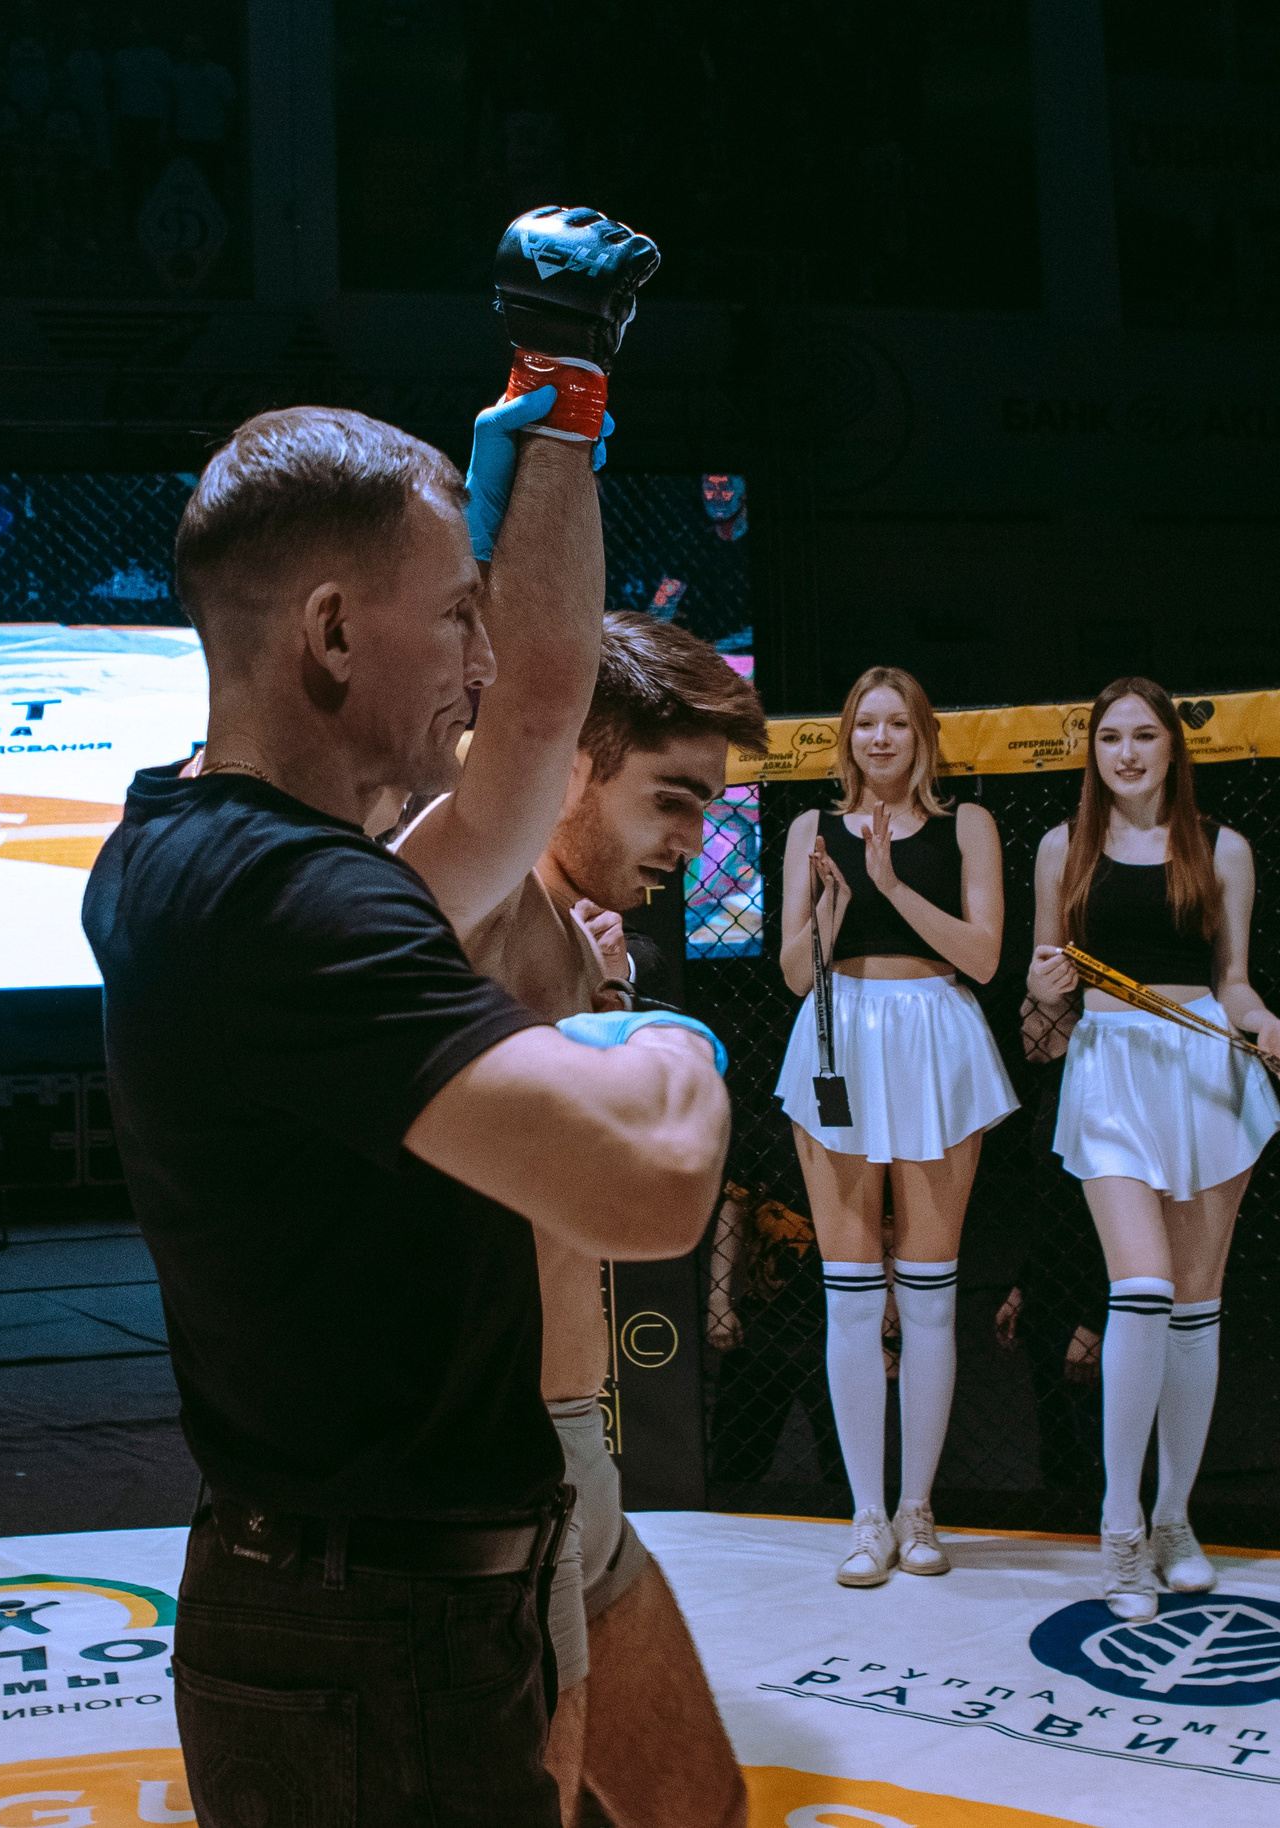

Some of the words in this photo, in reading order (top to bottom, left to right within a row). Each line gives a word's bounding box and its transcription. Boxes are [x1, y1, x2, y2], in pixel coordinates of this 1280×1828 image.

[1008, 739, 1064, 750] СЕРЕБРЯНЫЙ
[3, 1672, 119, 1696] МЫ
[822, 1656, 1055, 1703] ГРУППА
[1088, 1705, 1267, 1741] КОМП
[793, 1670, 1270, 1766] РАЗВИТ
